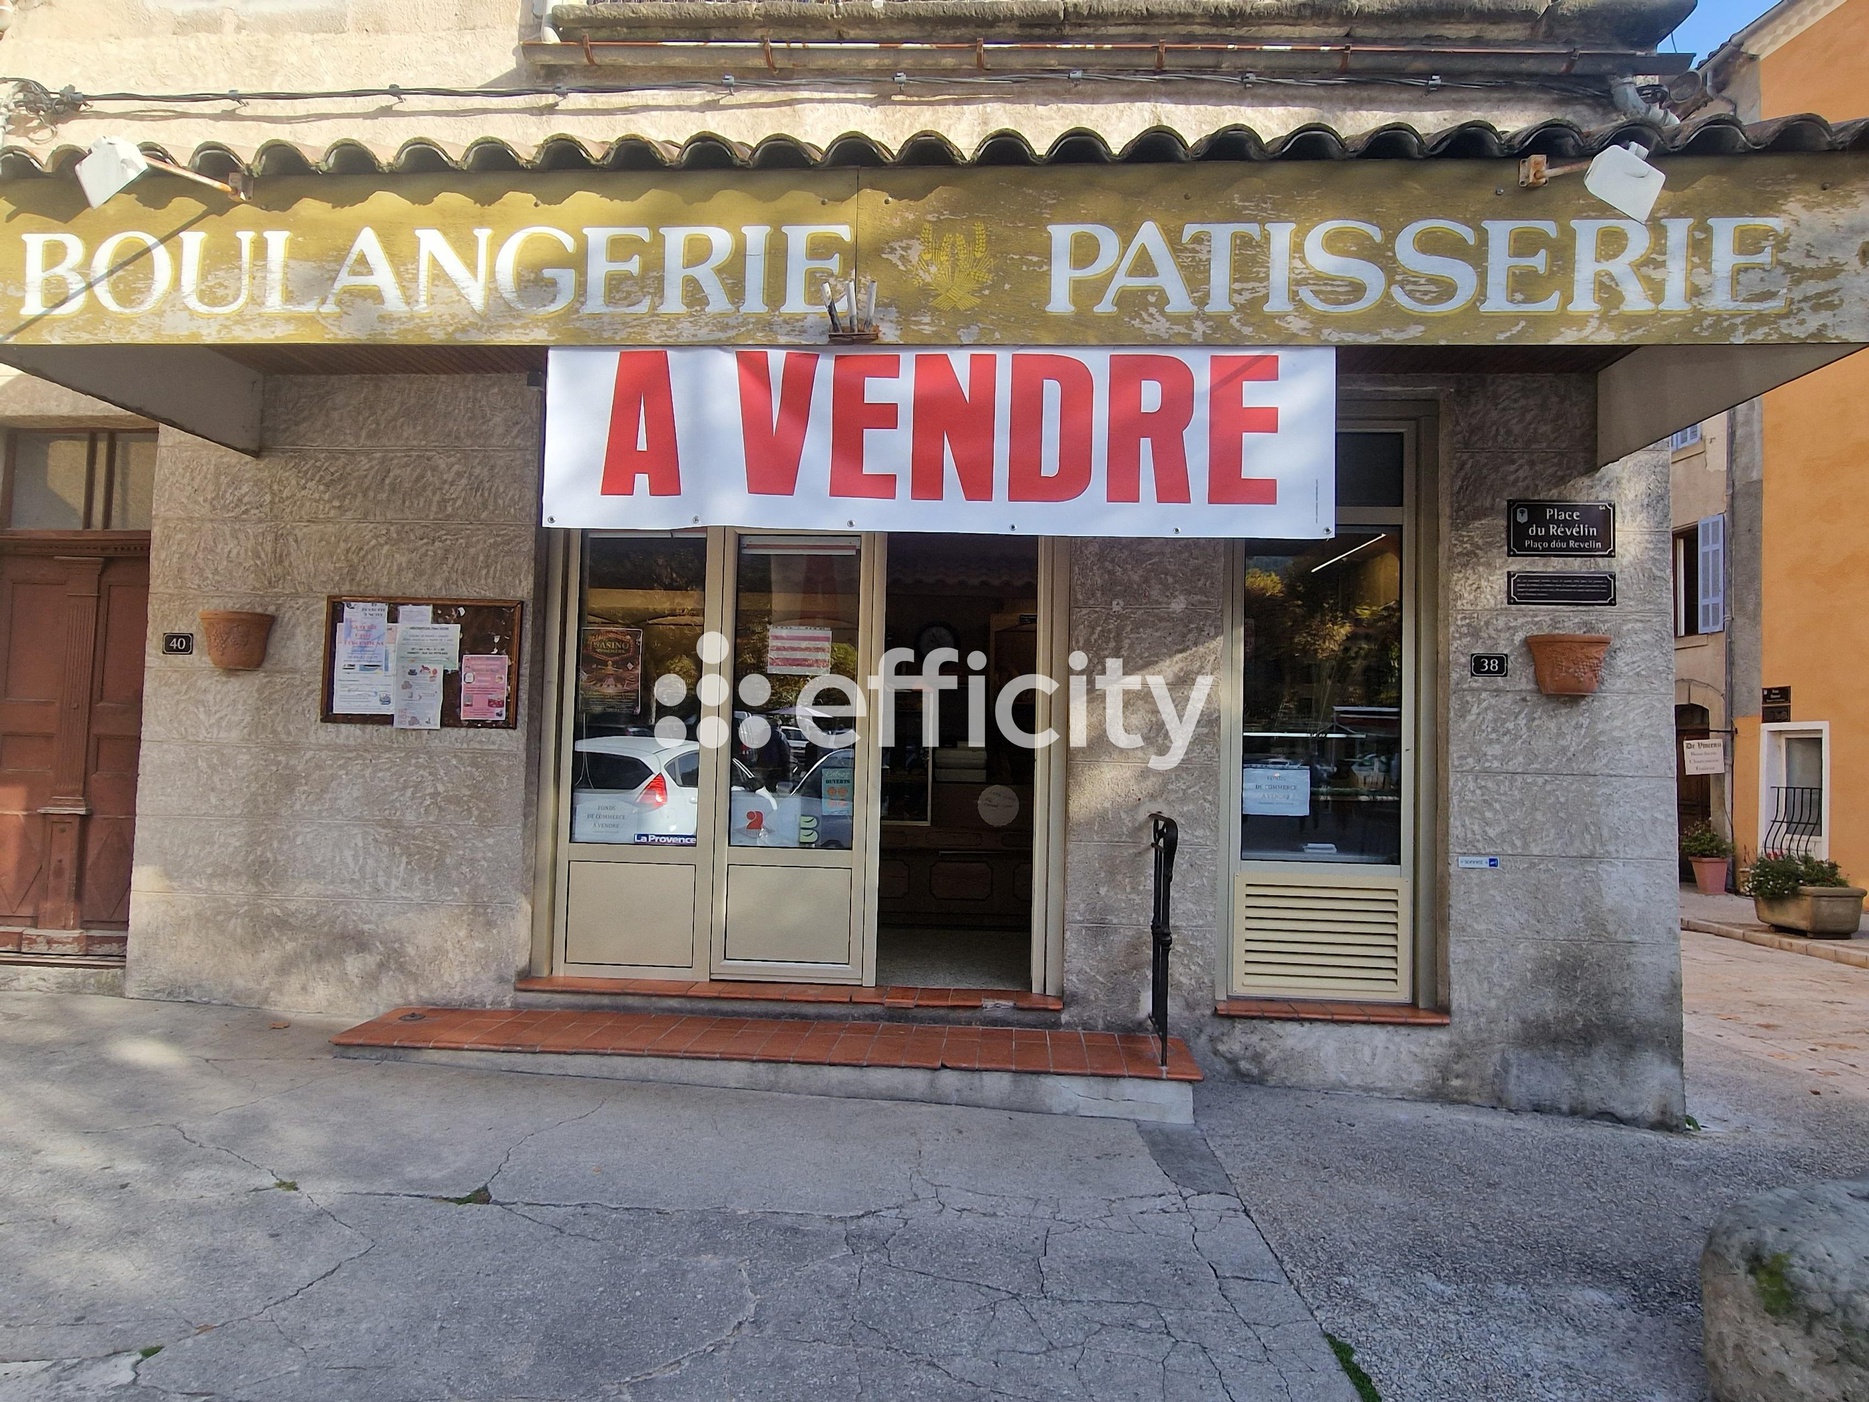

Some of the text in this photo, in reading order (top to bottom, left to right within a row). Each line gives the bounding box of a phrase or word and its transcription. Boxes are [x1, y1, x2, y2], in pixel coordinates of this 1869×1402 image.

[20, 217, 1789, 318] BOULANGERIE PATISSERIE
[600, 350, 1279, 505] A VENDRE
[1546, 508, 1581, 520] Place
[1528, 523, 1598, 537] du Révélin
[1524, 539, 1549, 550] Plaço
[1569, 539, 1602, 549] Revelin
[169, 638, 186, 650] 40
[1480, 658, 1499, 672] 38
[634, 834, 697, 844] La Provence
